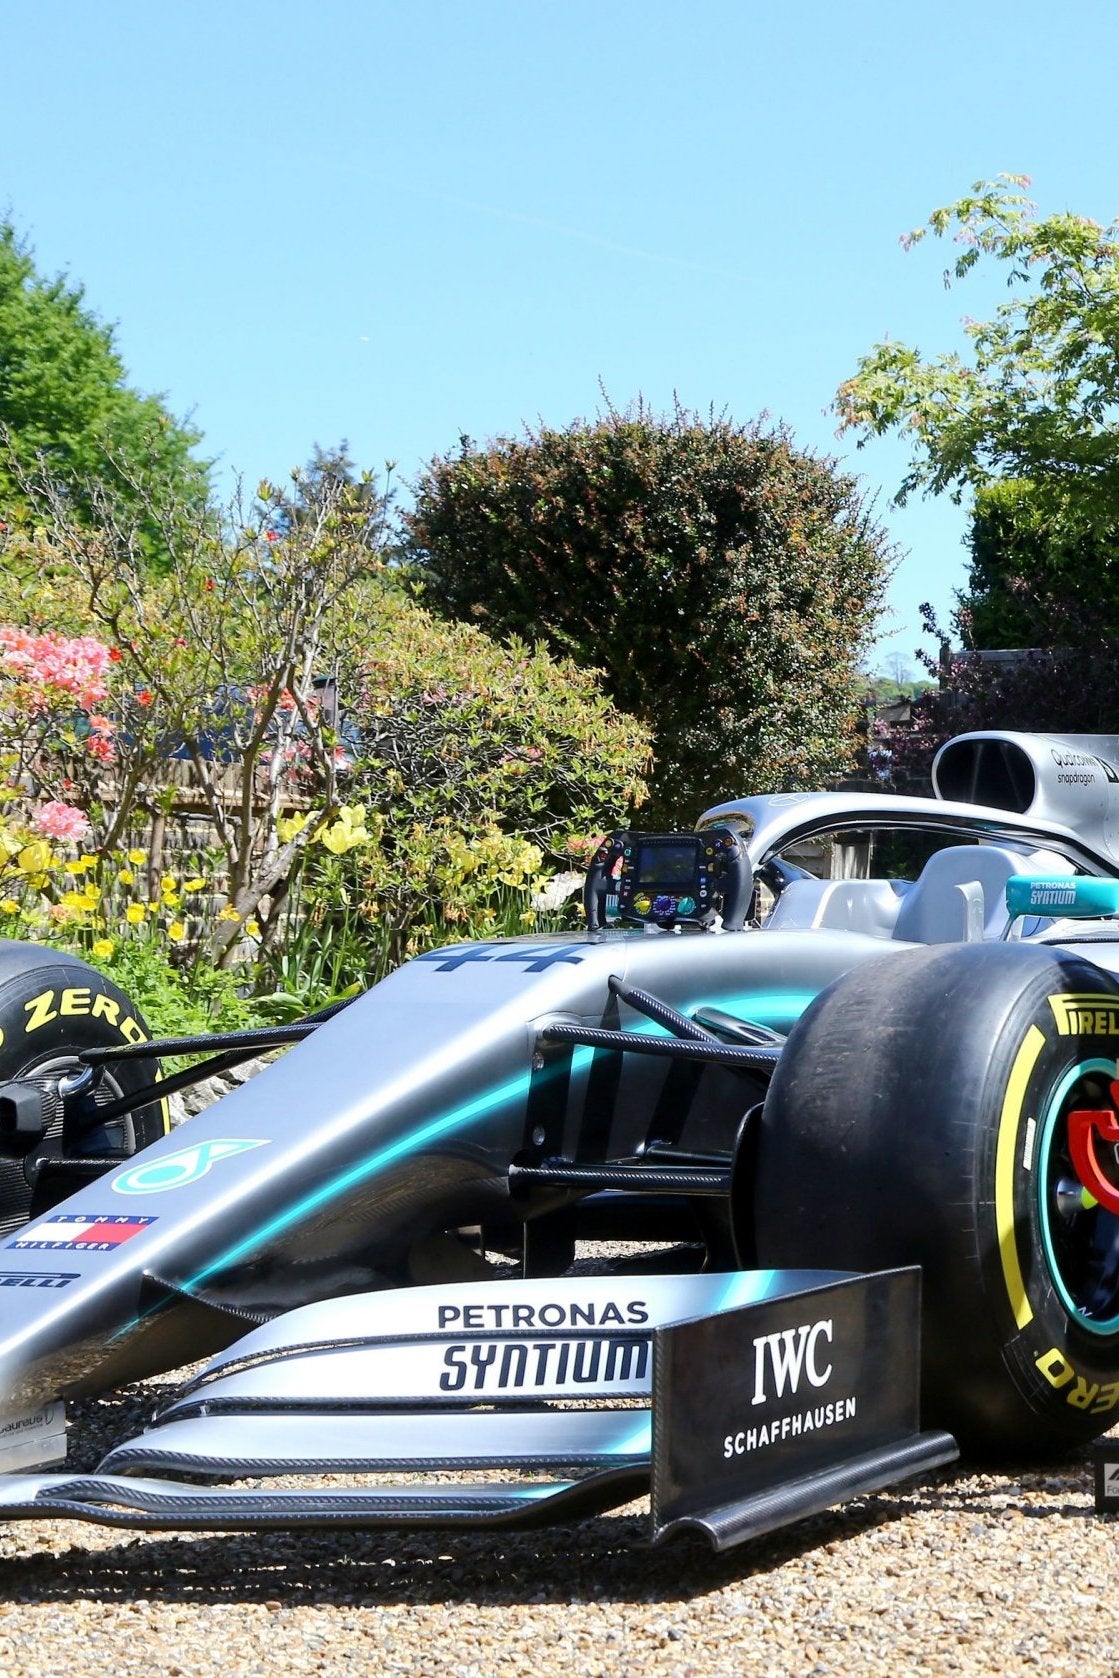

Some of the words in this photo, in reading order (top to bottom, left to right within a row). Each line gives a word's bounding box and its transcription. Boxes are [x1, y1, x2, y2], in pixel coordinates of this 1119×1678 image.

[1057, 772, 1096, 787] snapdragon
[1030, 881, 1076, 890] PETRONAS
[1030, 890, 1077, 905] SYNTIUM
[414, 941, 600, 973] 44
[24, 988, 149, 1045] ZERO
[57, 1216, 149, 1224] TOMMY
[15, 1241, 110, 1250] HILFIGER
[438, 1301, 649, 1329] PETRONAS
[439, 1340, 650, 1391] SYNTIUM
[751, 1319, 833, 1406] IWC
[723, 1396, 856, 1459] SCHAFFHAUSEN
